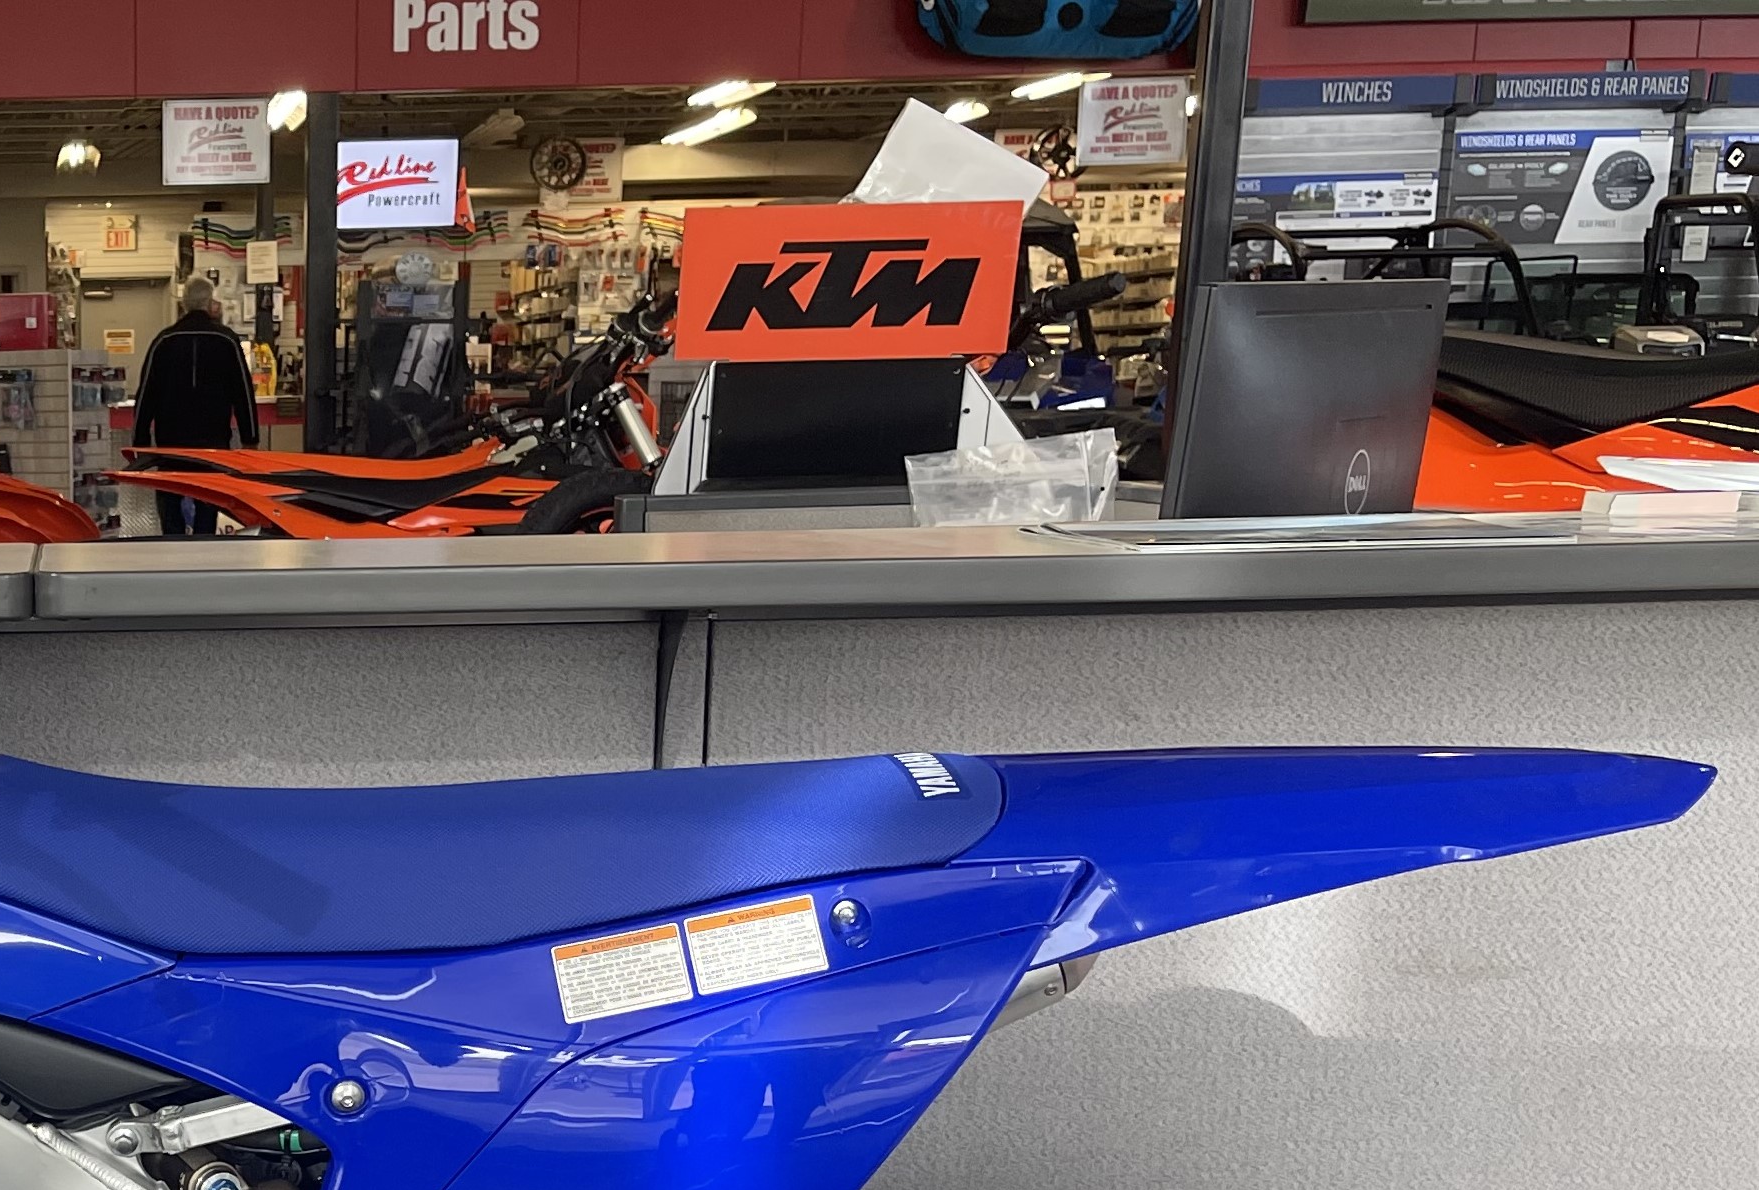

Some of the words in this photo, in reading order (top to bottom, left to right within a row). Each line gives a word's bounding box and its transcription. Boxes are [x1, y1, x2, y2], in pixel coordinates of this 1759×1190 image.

[393, 0, 541, 53] Parts
[1122, 86, 1129, 100] A
[1132, 84, 1178, 101] QUOTE?
[1322, 81, 1393, 103] WINCHES
[1496, 78, 1588, 99] WINDSHIELDS
[1604, 76, 1638, 96] REAR
[1641, 76, 1690, 95] PANELS
[205, 106, 213, 120] A
[215, 106, 259, 121] QUOTE?
[1460, 134, 1517, 148] WINDSHIELDS
[1524, 134, 1545, 146] REAR
[1546, 133, 1577, 146] PANELS
[368, 192, 440, 207] Powercraft
[107, 230, 131, 249] EXIT
[705, 238, 981, 332] KTM
[1347, 474, 1367, 493] DELL
